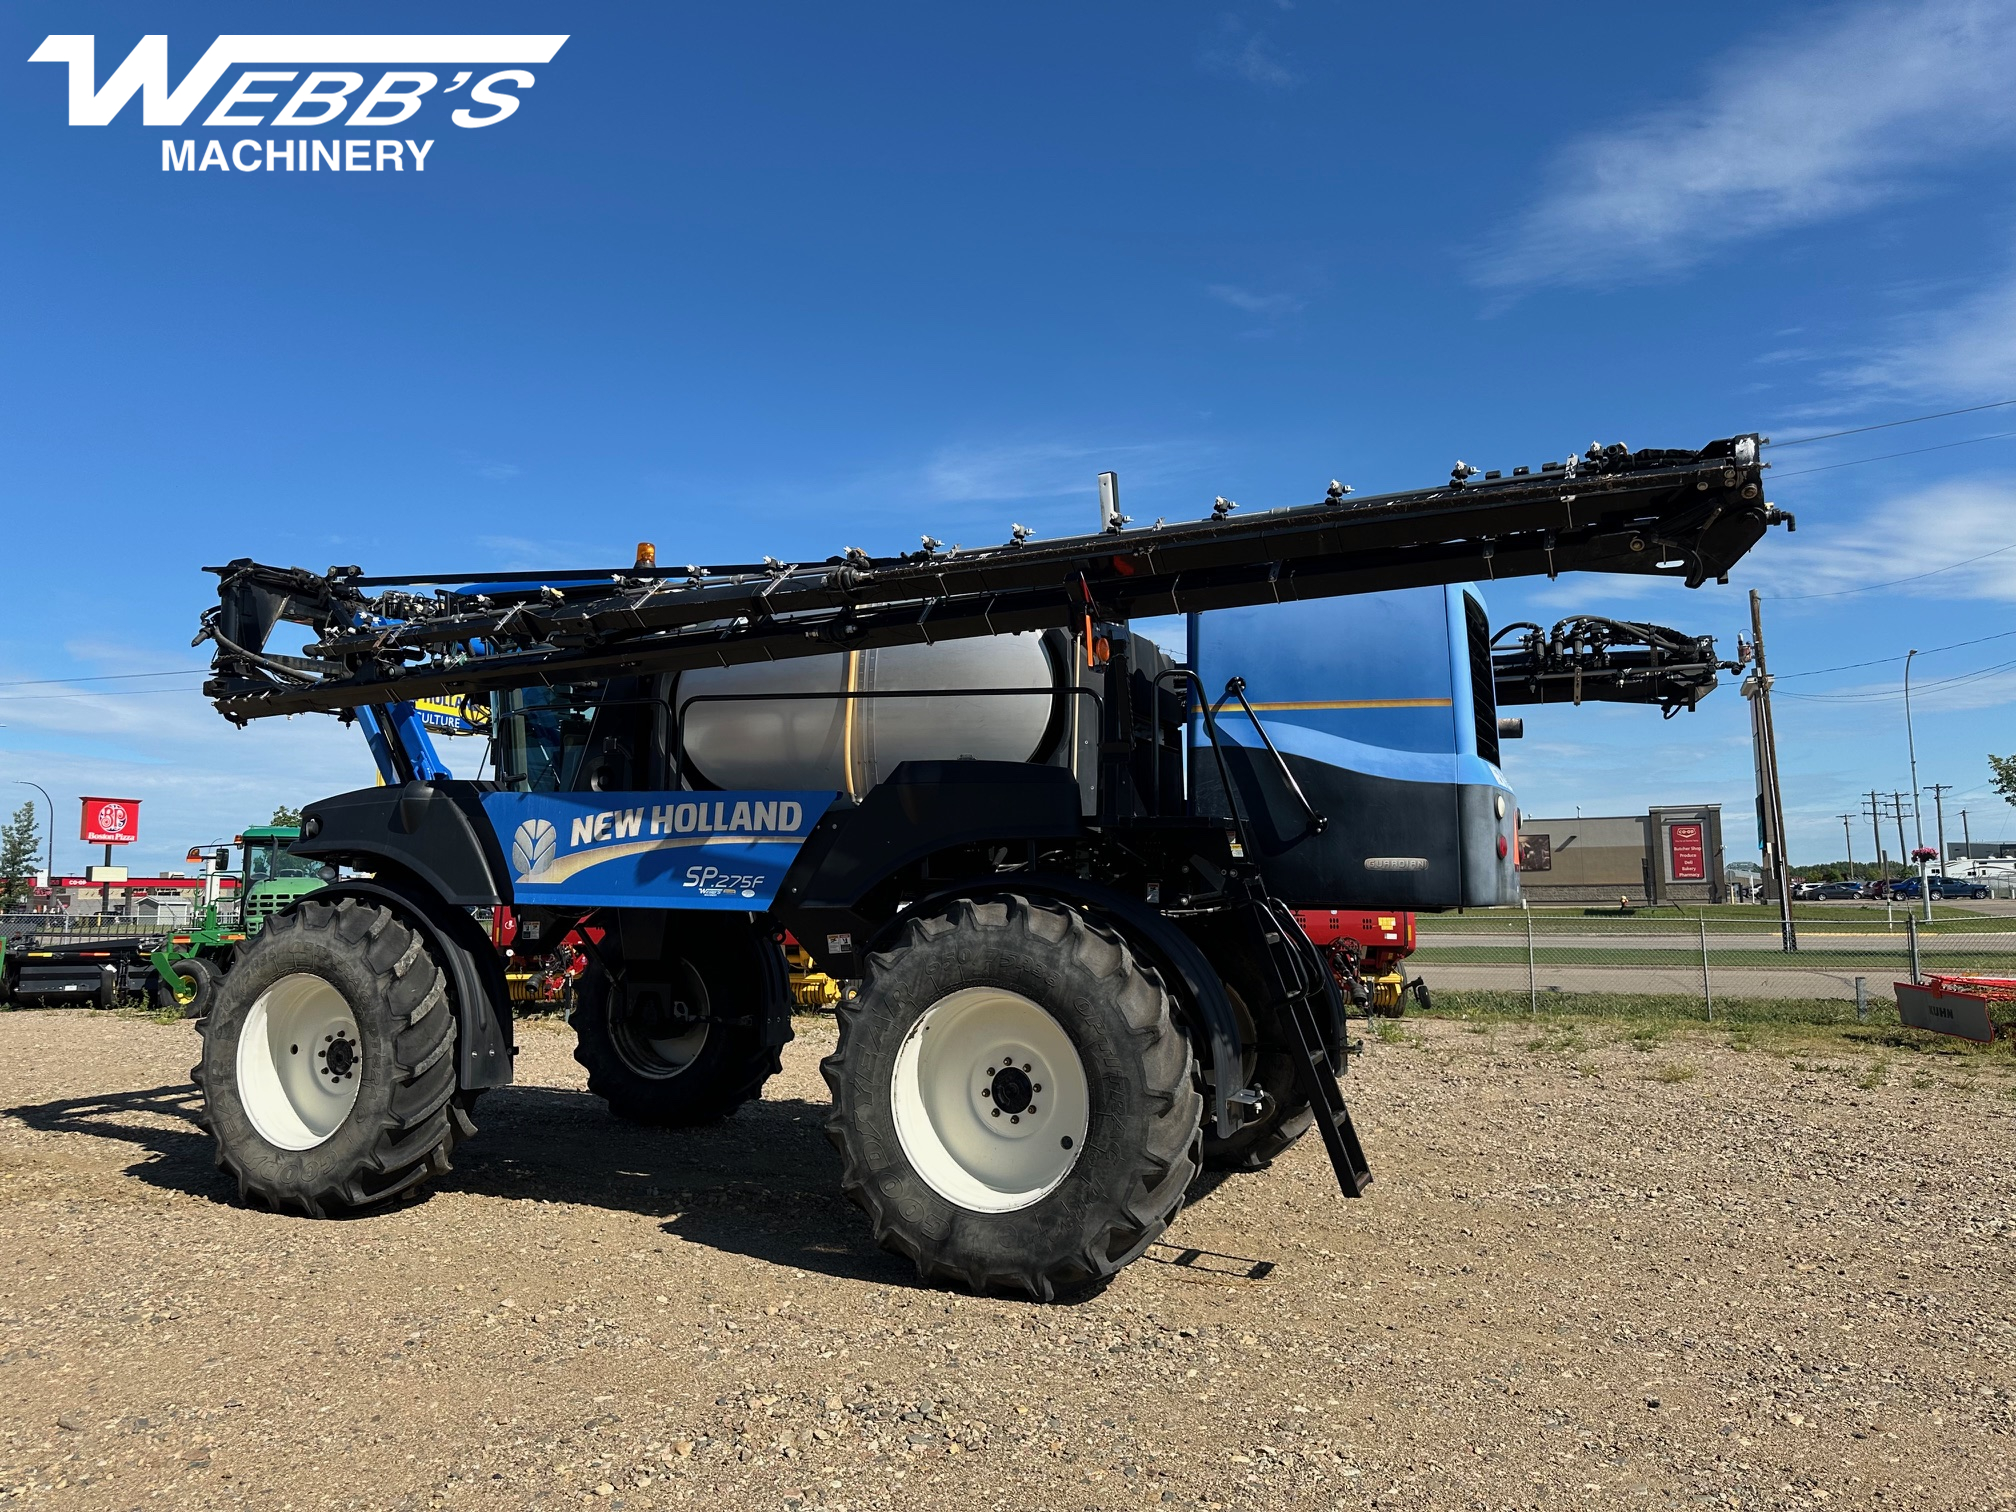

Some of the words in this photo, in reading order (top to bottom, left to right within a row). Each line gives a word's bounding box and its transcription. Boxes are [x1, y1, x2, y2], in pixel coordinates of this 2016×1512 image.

[417, 711, 461, 728] ULTURE
[570, 806, 645, 848] NEW
[650, 801, 803, 836] HOLLAND
[88, 832, 115, 840] Boston
[115, 833, 136, 841] Pizza
[1368, 859, 1424, 869] GUARDIAN
[1928, 1005, 1954, 1019] KUHN
[852, 979, 951, 1242] GOODYEAR
[211, 1058, 339, 1185] GOODYEAR
